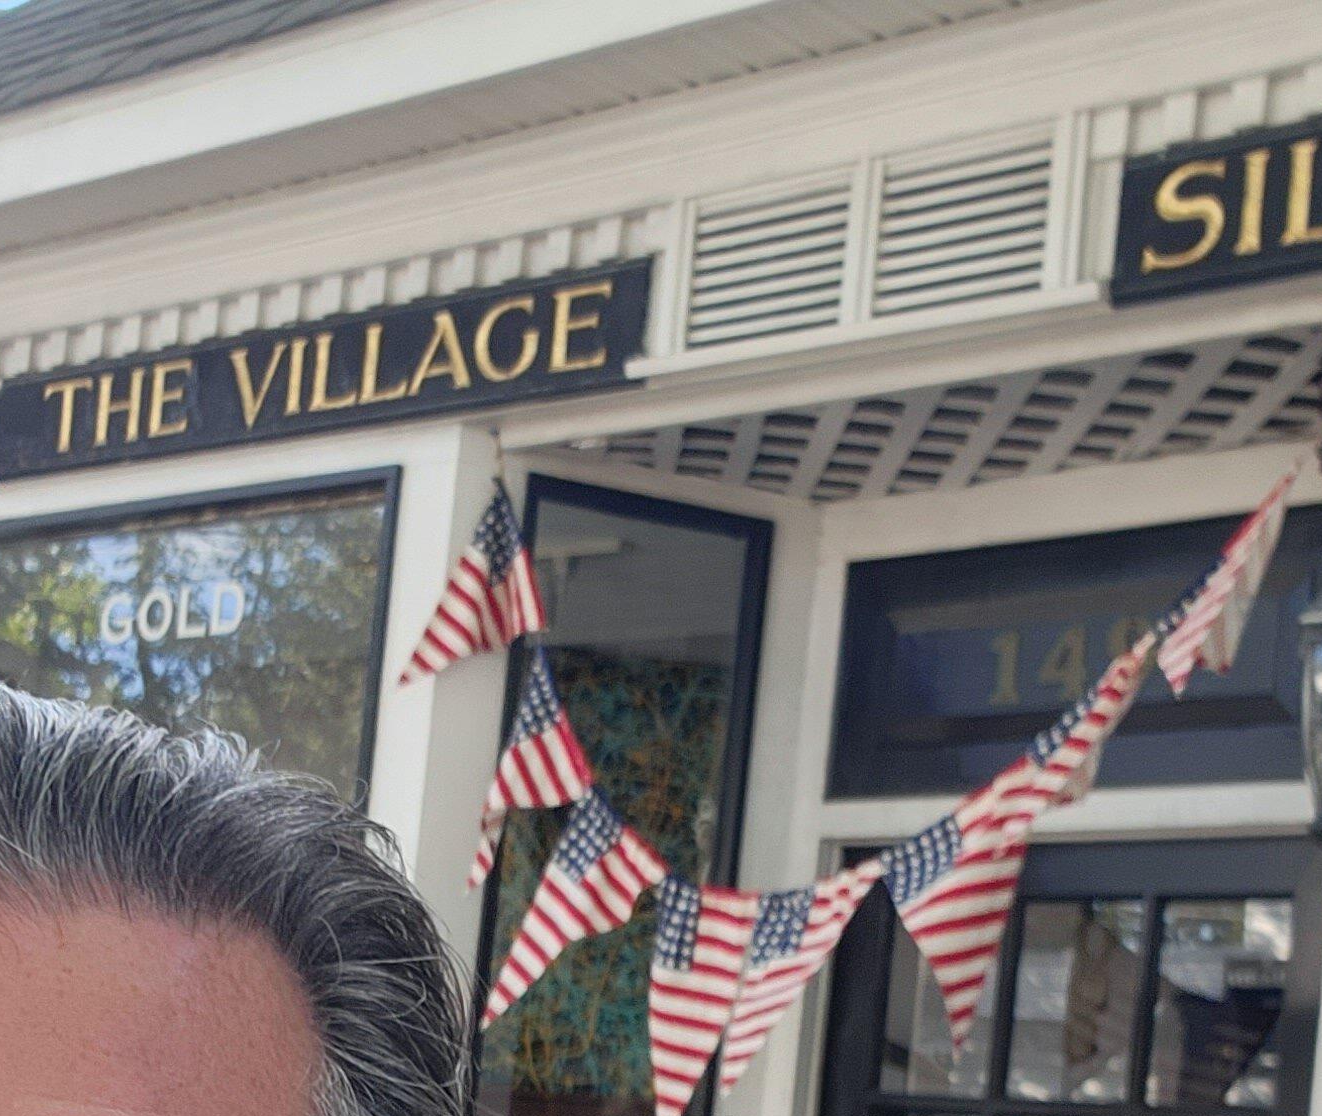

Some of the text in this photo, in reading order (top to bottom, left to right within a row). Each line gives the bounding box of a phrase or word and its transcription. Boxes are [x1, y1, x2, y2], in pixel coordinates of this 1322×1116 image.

[44, 279, 615, 454] THE VILLAGE
[100, 578, 245, 646] GOLD
